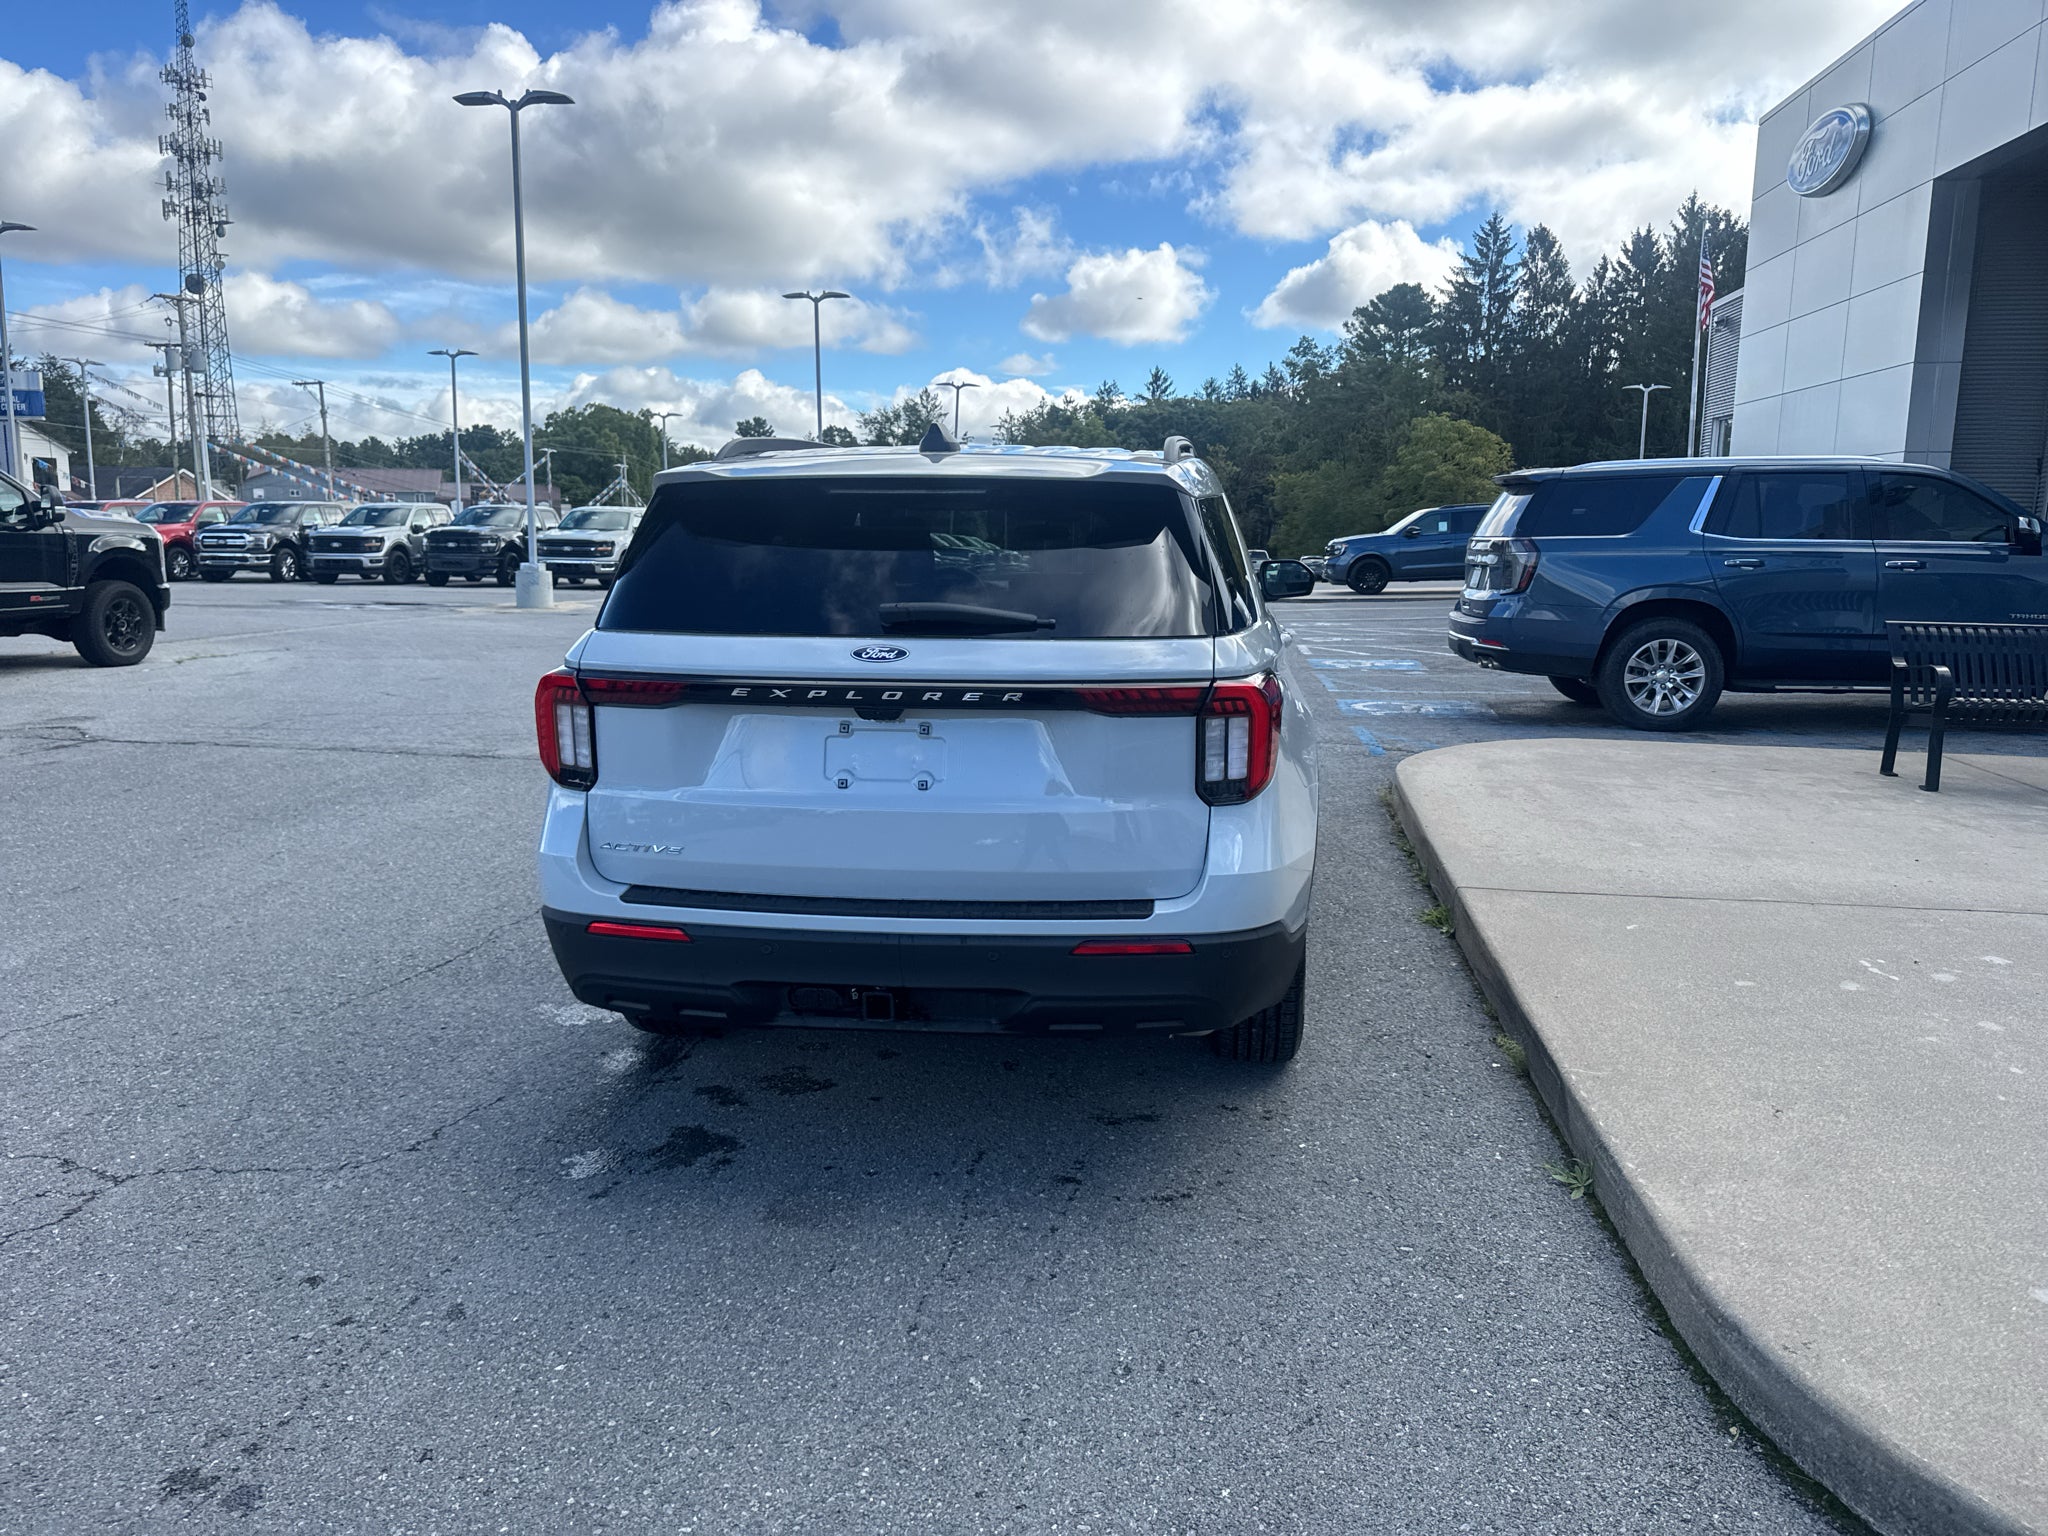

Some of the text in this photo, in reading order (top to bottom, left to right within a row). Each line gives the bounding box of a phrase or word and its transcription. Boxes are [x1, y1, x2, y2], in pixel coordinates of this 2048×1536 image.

[1797, 127, 1837, 183] Ford
[860, 647, 898, 660] Ford
[730, 687, 1024, 702] EXPLORER
[600, 842, 685, 855] ACTIVE
